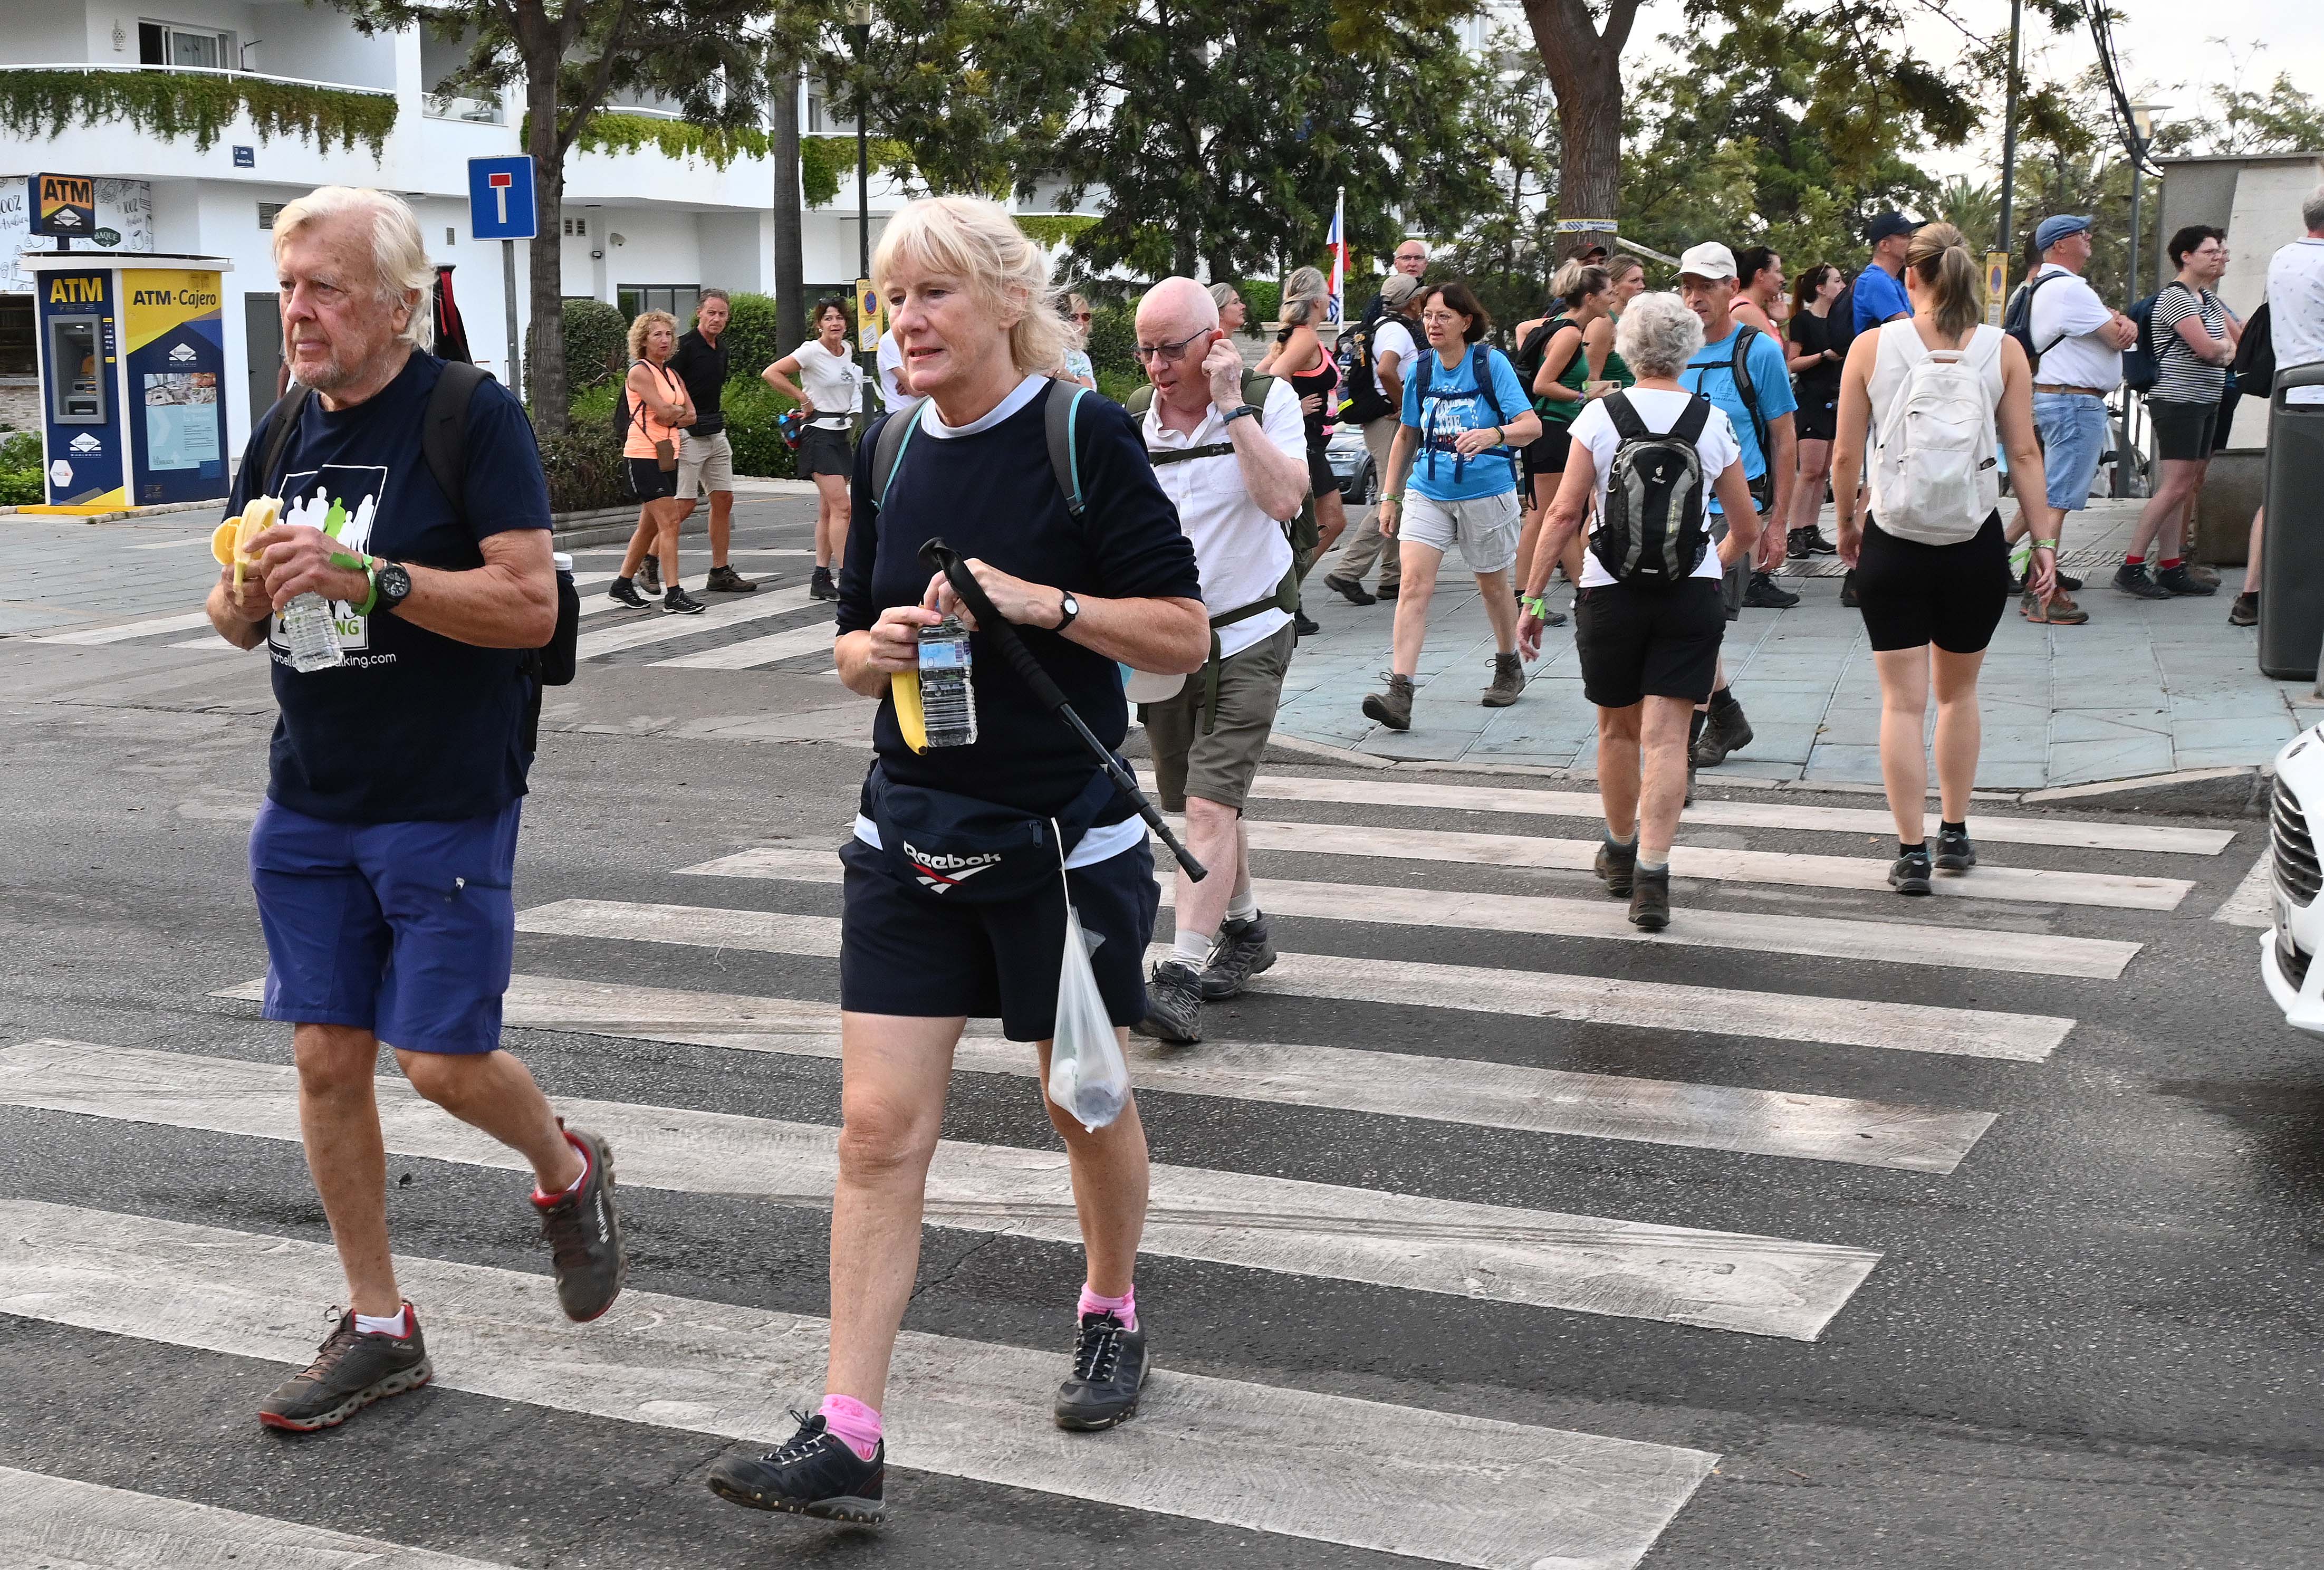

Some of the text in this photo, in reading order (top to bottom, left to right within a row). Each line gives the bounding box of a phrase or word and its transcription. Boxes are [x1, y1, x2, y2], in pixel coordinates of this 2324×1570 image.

[44, 179, 90, 203] ATM
[50, 277, 103, 303] ATM
[133, 289, 216, 309] ATM Cajero
[904, 840, 1001, 869] Reebok
